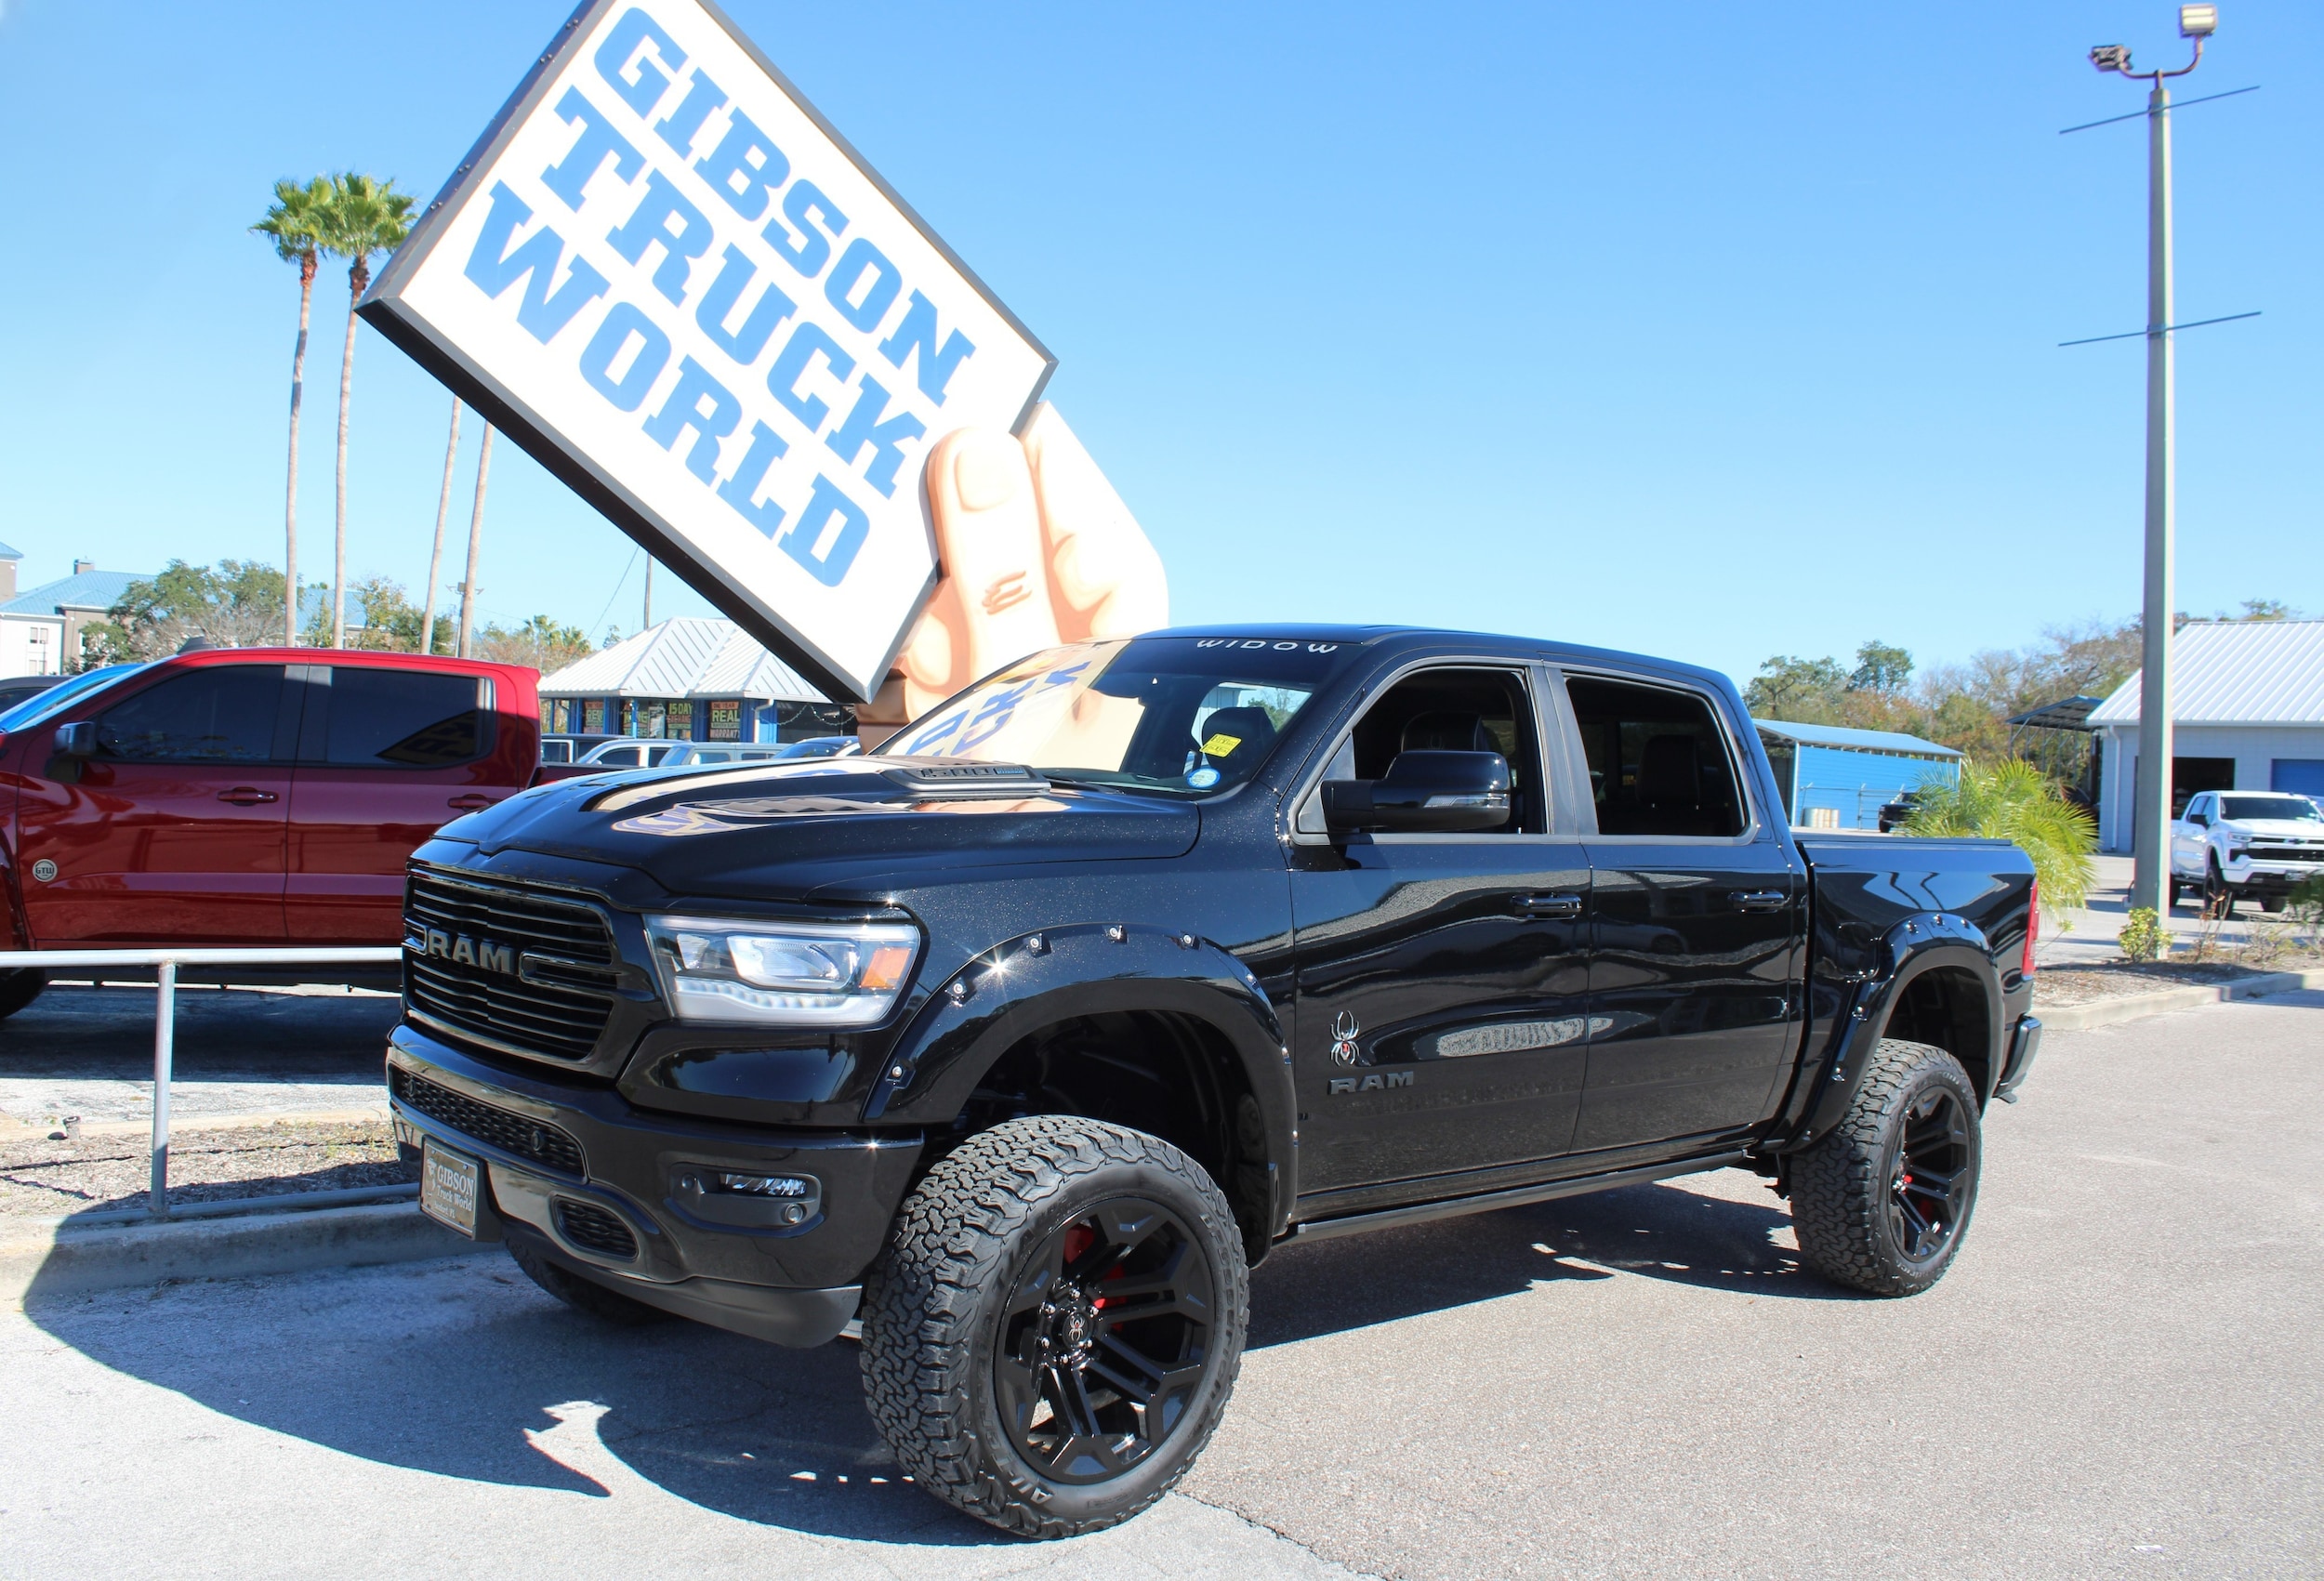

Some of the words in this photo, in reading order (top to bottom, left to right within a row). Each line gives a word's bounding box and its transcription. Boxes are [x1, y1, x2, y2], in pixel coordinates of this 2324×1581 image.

[593, 7, 977, 409] GIBSON
[539, 85, 928, 500] TRUCK
[463, 178, 871, 587] WORLD
[1196, 639, 1339, 654] WIDOW
[678, 703, 693, 715] DAY
[712, 709, 741, 722] REAL
[35, 866, 55, 875] GTW
[428, 929, 513, 974] RAM
[1328, 1071, 1414, 1095] RAM
[437, 1165, 474, 1197] GIBSON
[437, 1185, 453, 1203] Truck
[454, 1192, 472, 1212] World
